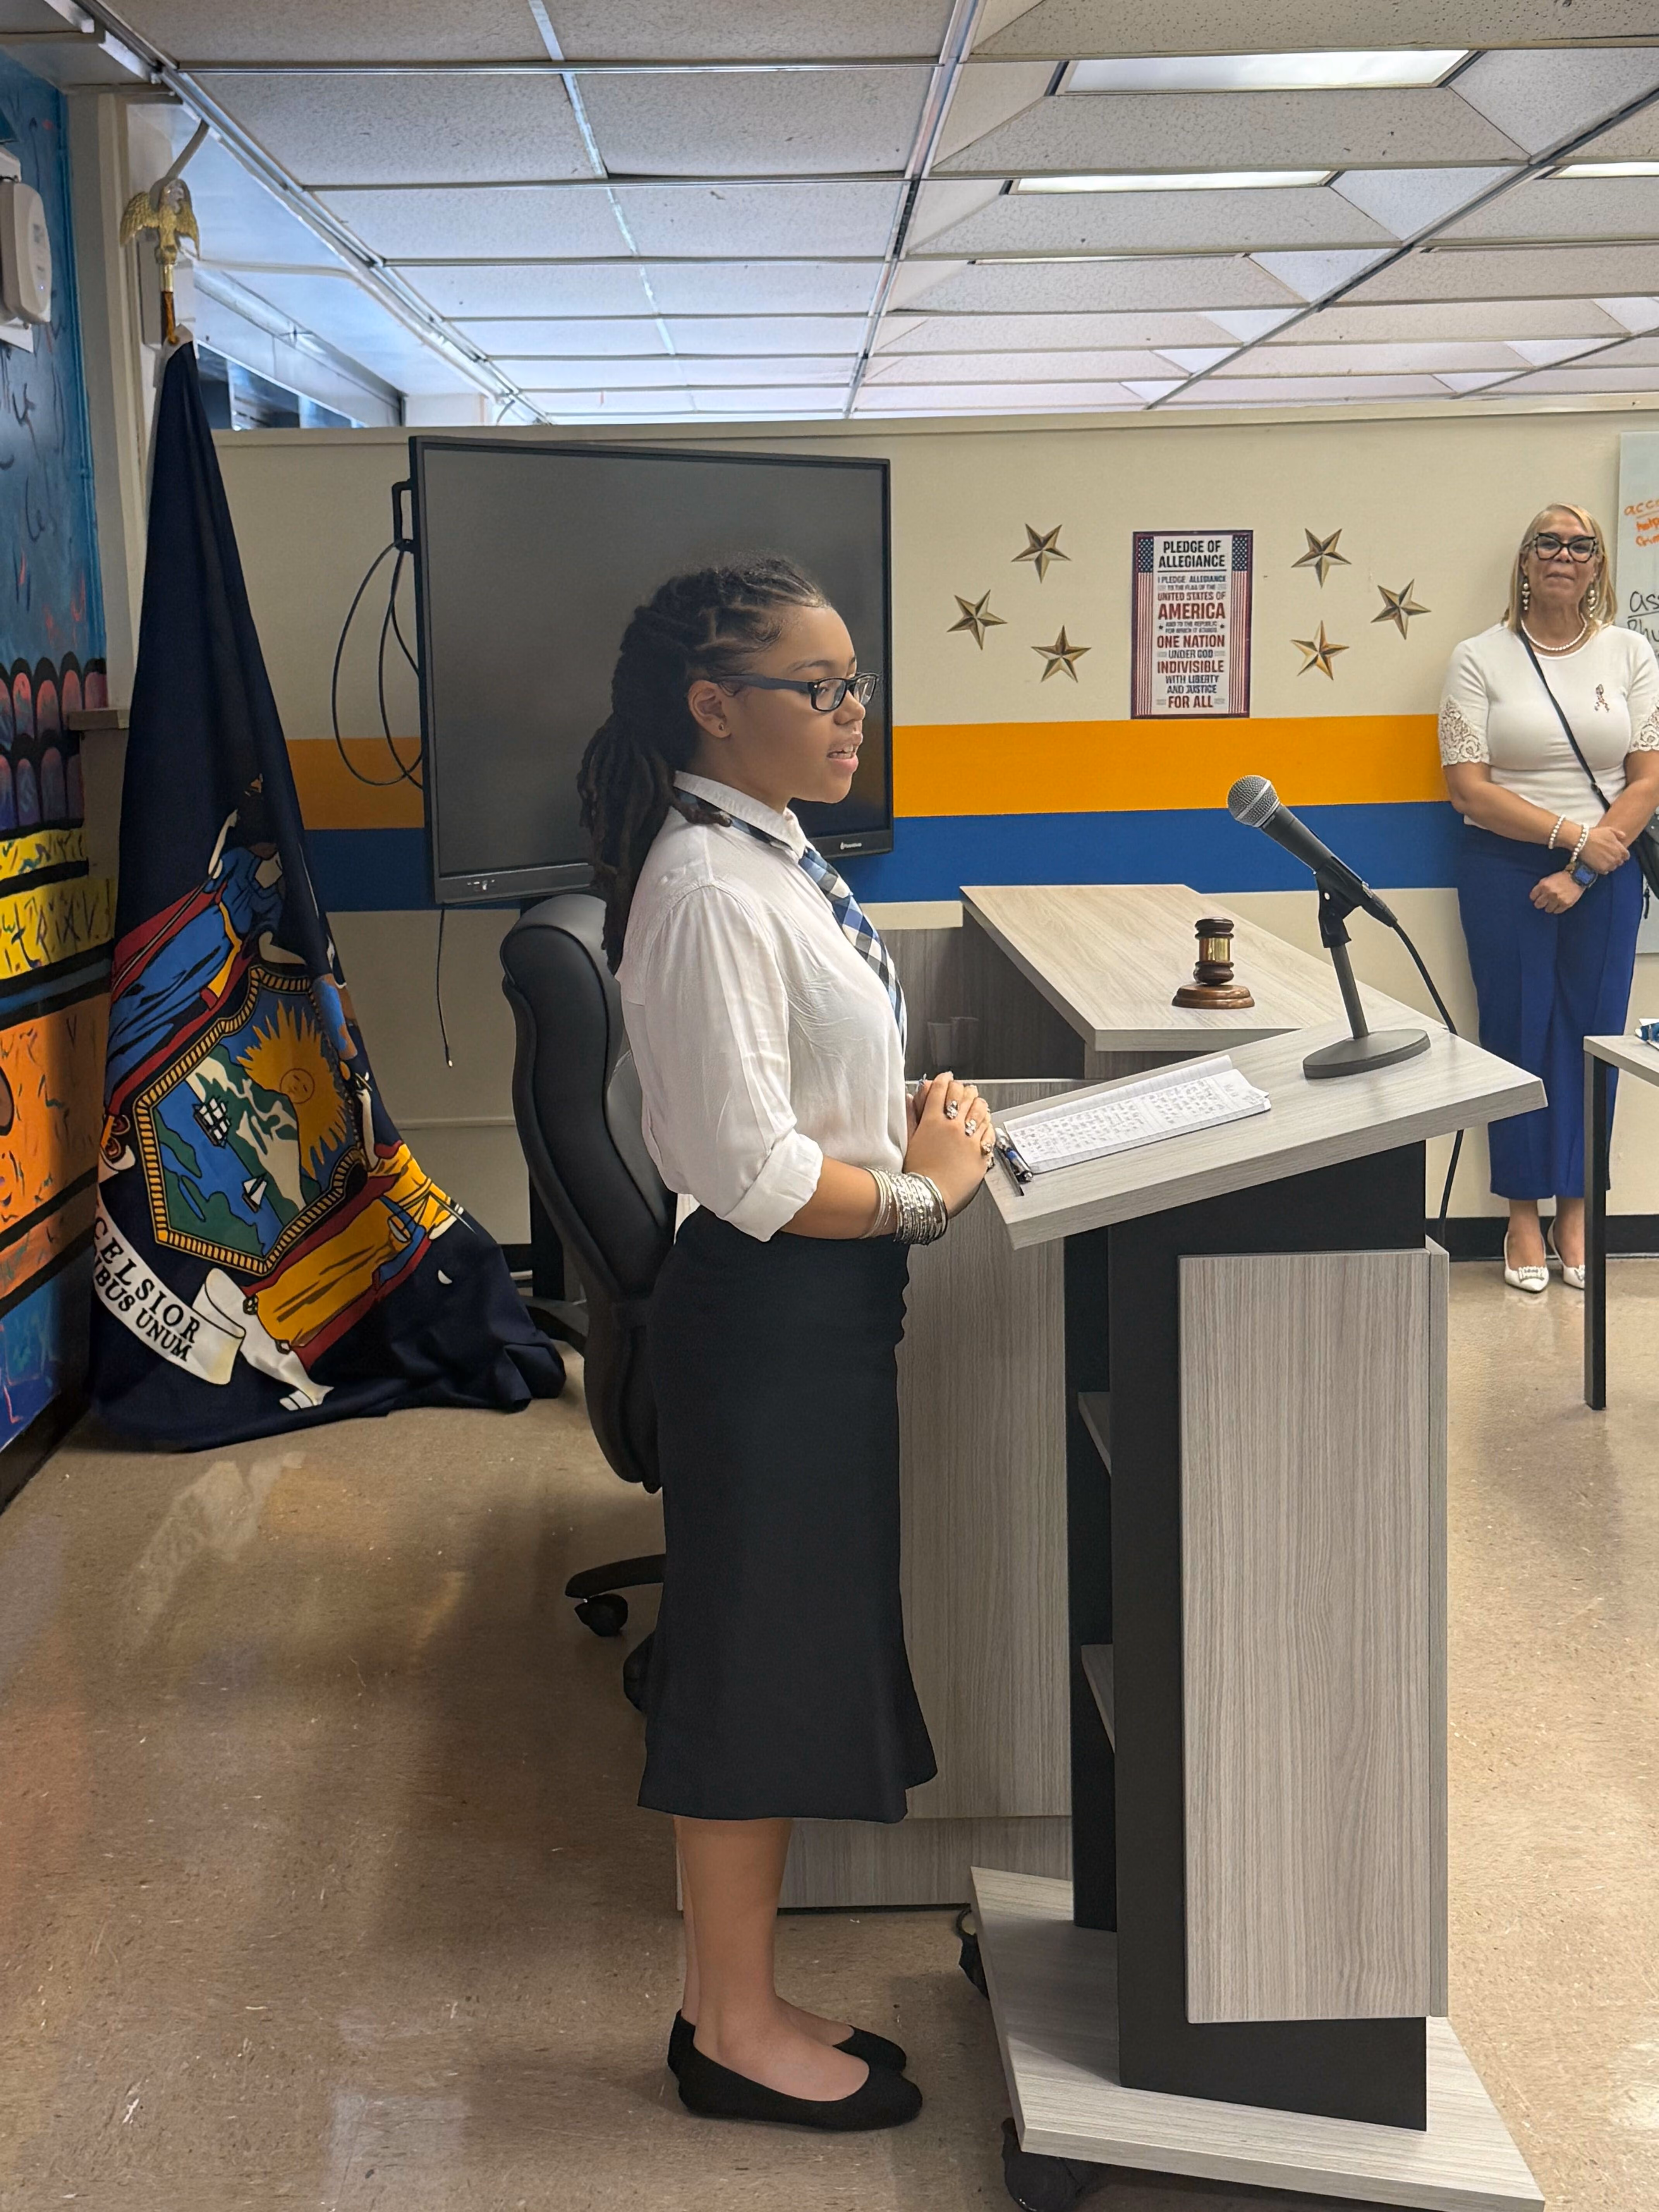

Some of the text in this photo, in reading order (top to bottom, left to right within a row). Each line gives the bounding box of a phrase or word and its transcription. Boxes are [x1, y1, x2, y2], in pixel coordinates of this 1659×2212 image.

[1163, 540, 1221, 553] PLEDGE OF
[1159, 555, 1225, 568] ALLEGIANCE
[1158, 591, 1226, 601] UNITED STATES OF
[1630, 591, 1659, 612] as
[1158, 603, 1226, 620] AMERICA
[1157, 635, 1224, 648] ONE NATION
[1169, 650, 1213, 658] UNDER GOD
[1158, 660, 1224, 673] INDIVISIBLE
[1166, 675, 1219, 684] WITH LIBERTY
[1167, 685, 1217, 694] AND JUSTICE
[1168, 695, 1213, 708] FOR ALL
[136, 1308, 192, 1362] UNUM
